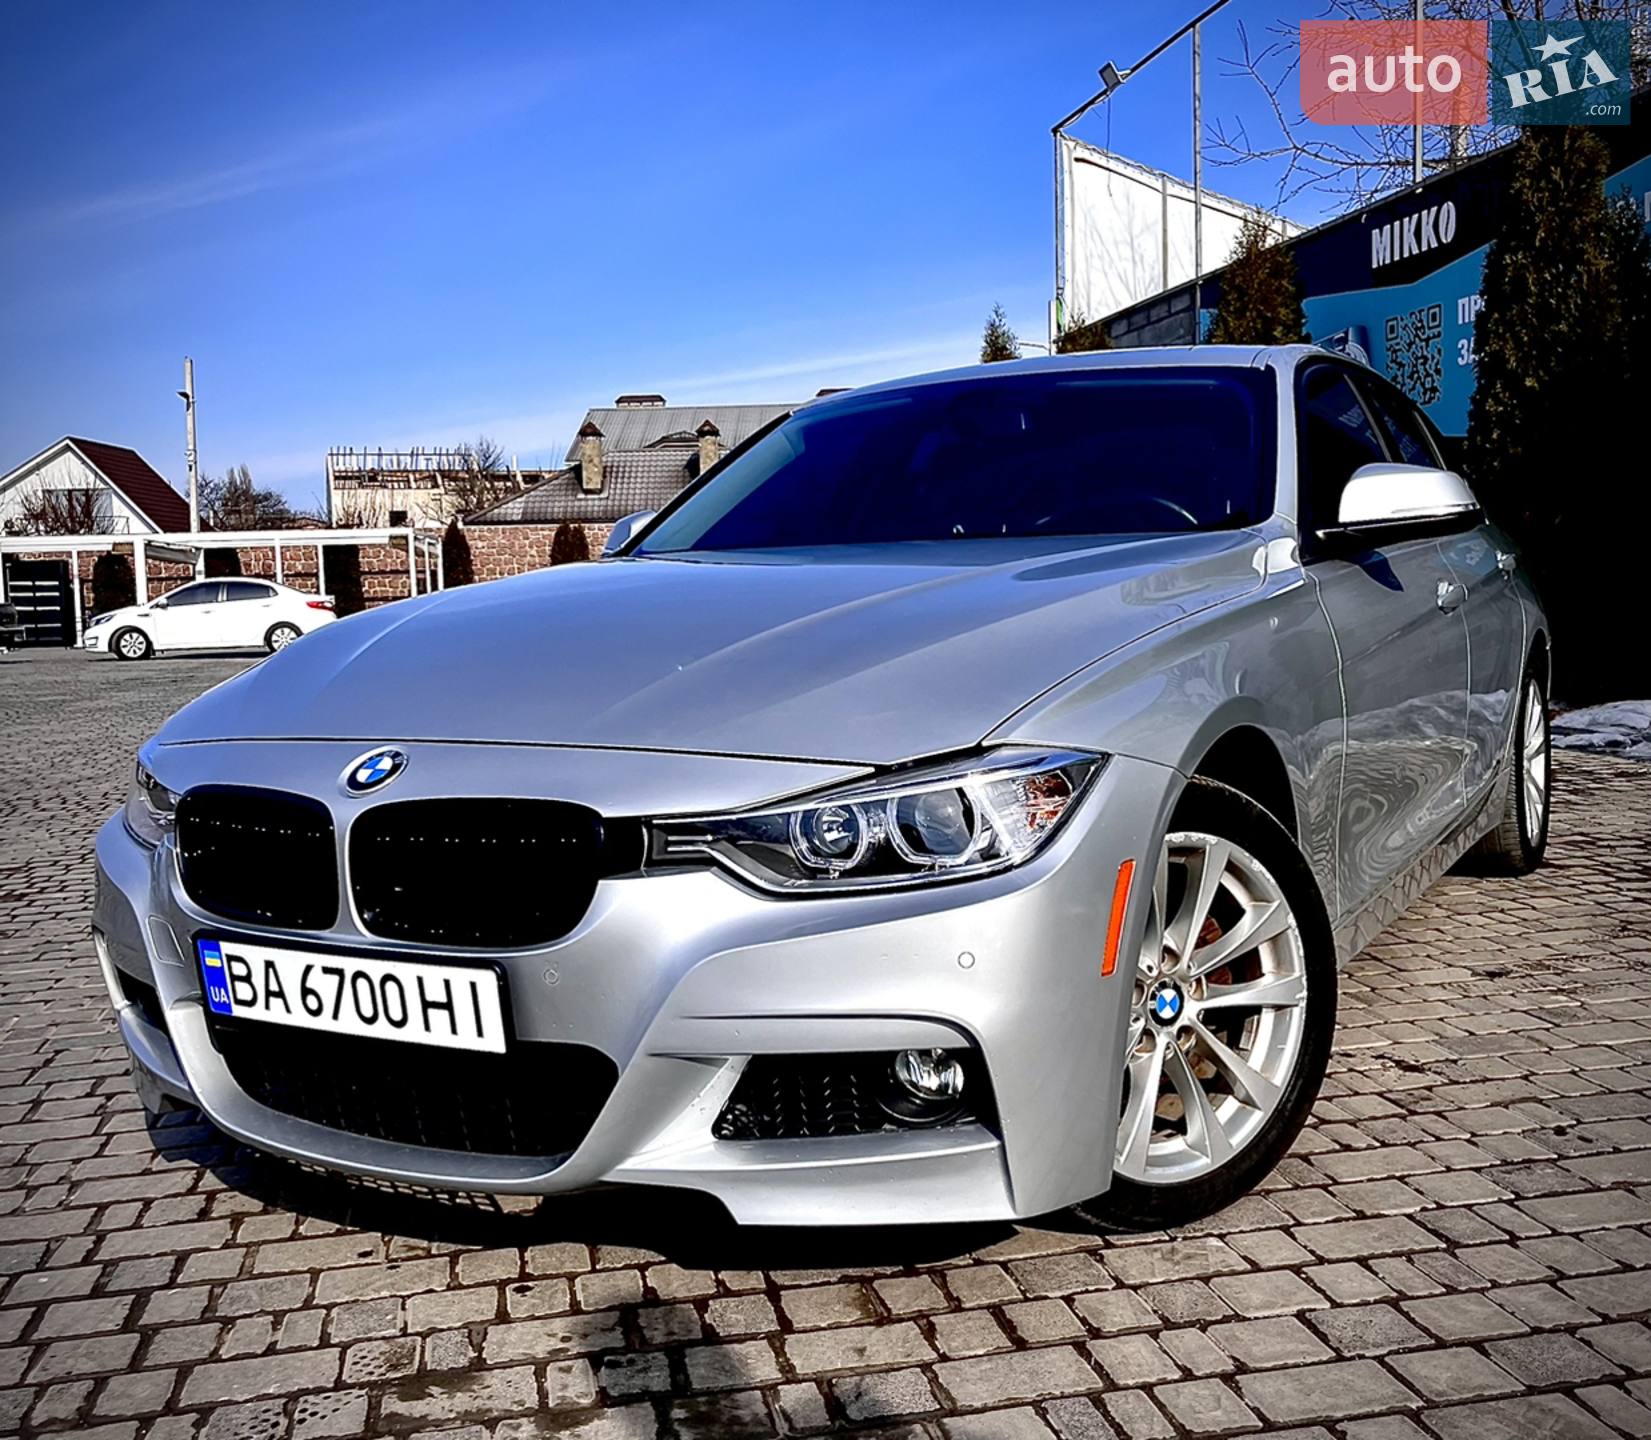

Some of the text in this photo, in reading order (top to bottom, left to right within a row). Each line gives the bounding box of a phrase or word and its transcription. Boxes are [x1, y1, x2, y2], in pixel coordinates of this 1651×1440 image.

[1371, 200, 1457, 269] MIKKO
[210, 985, 230, 1005] UA
[225, 953, 485, 1038] BA 6700 HI
